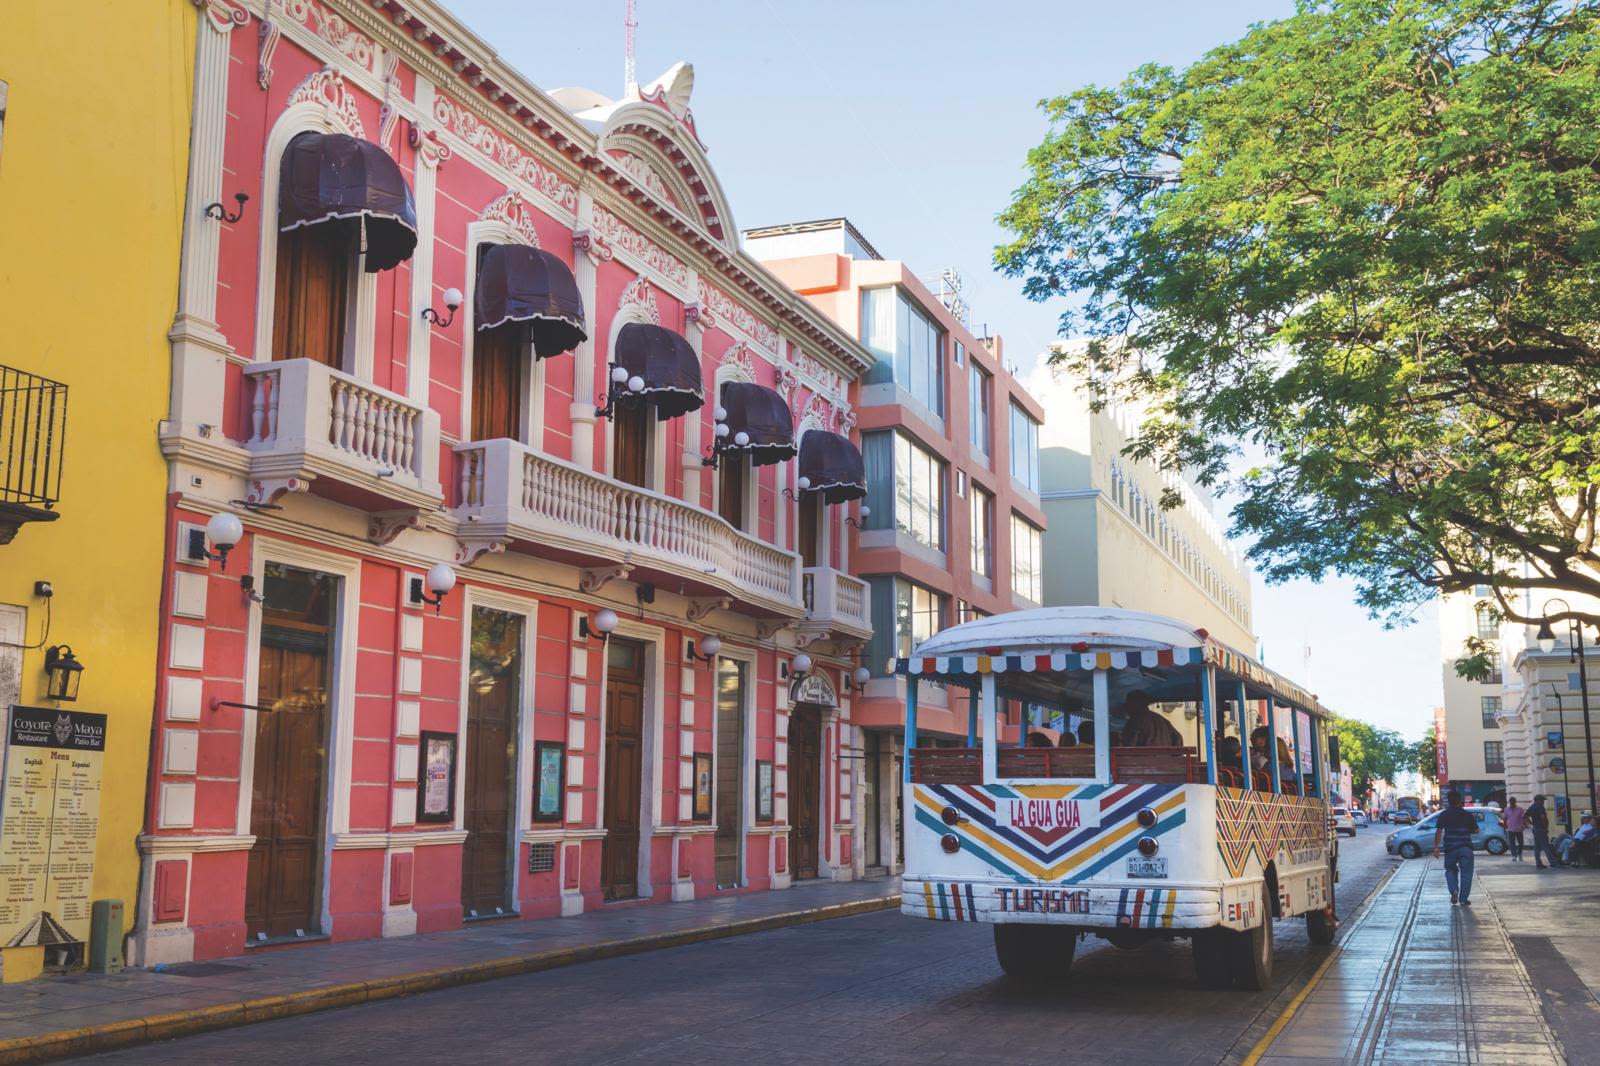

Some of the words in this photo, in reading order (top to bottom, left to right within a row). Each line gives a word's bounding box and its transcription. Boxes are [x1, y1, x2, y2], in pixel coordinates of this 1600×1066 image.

[14, 718, 52, 733] Coyote
[75, 723, 102, 737] Maya
[17, 733, 48, 743] Restaurant
[74, 737, 89, 746] Patio
[90, 738, 101, 746] Bar
[50, 751, 70, 761] Menu
[1010, 800, 1025, 827] LA
[1028, 800, 1053, 828] GUA
[1056, 800, 1081, 828] GUA
[994, 887, 1090, 913] TURISMO
